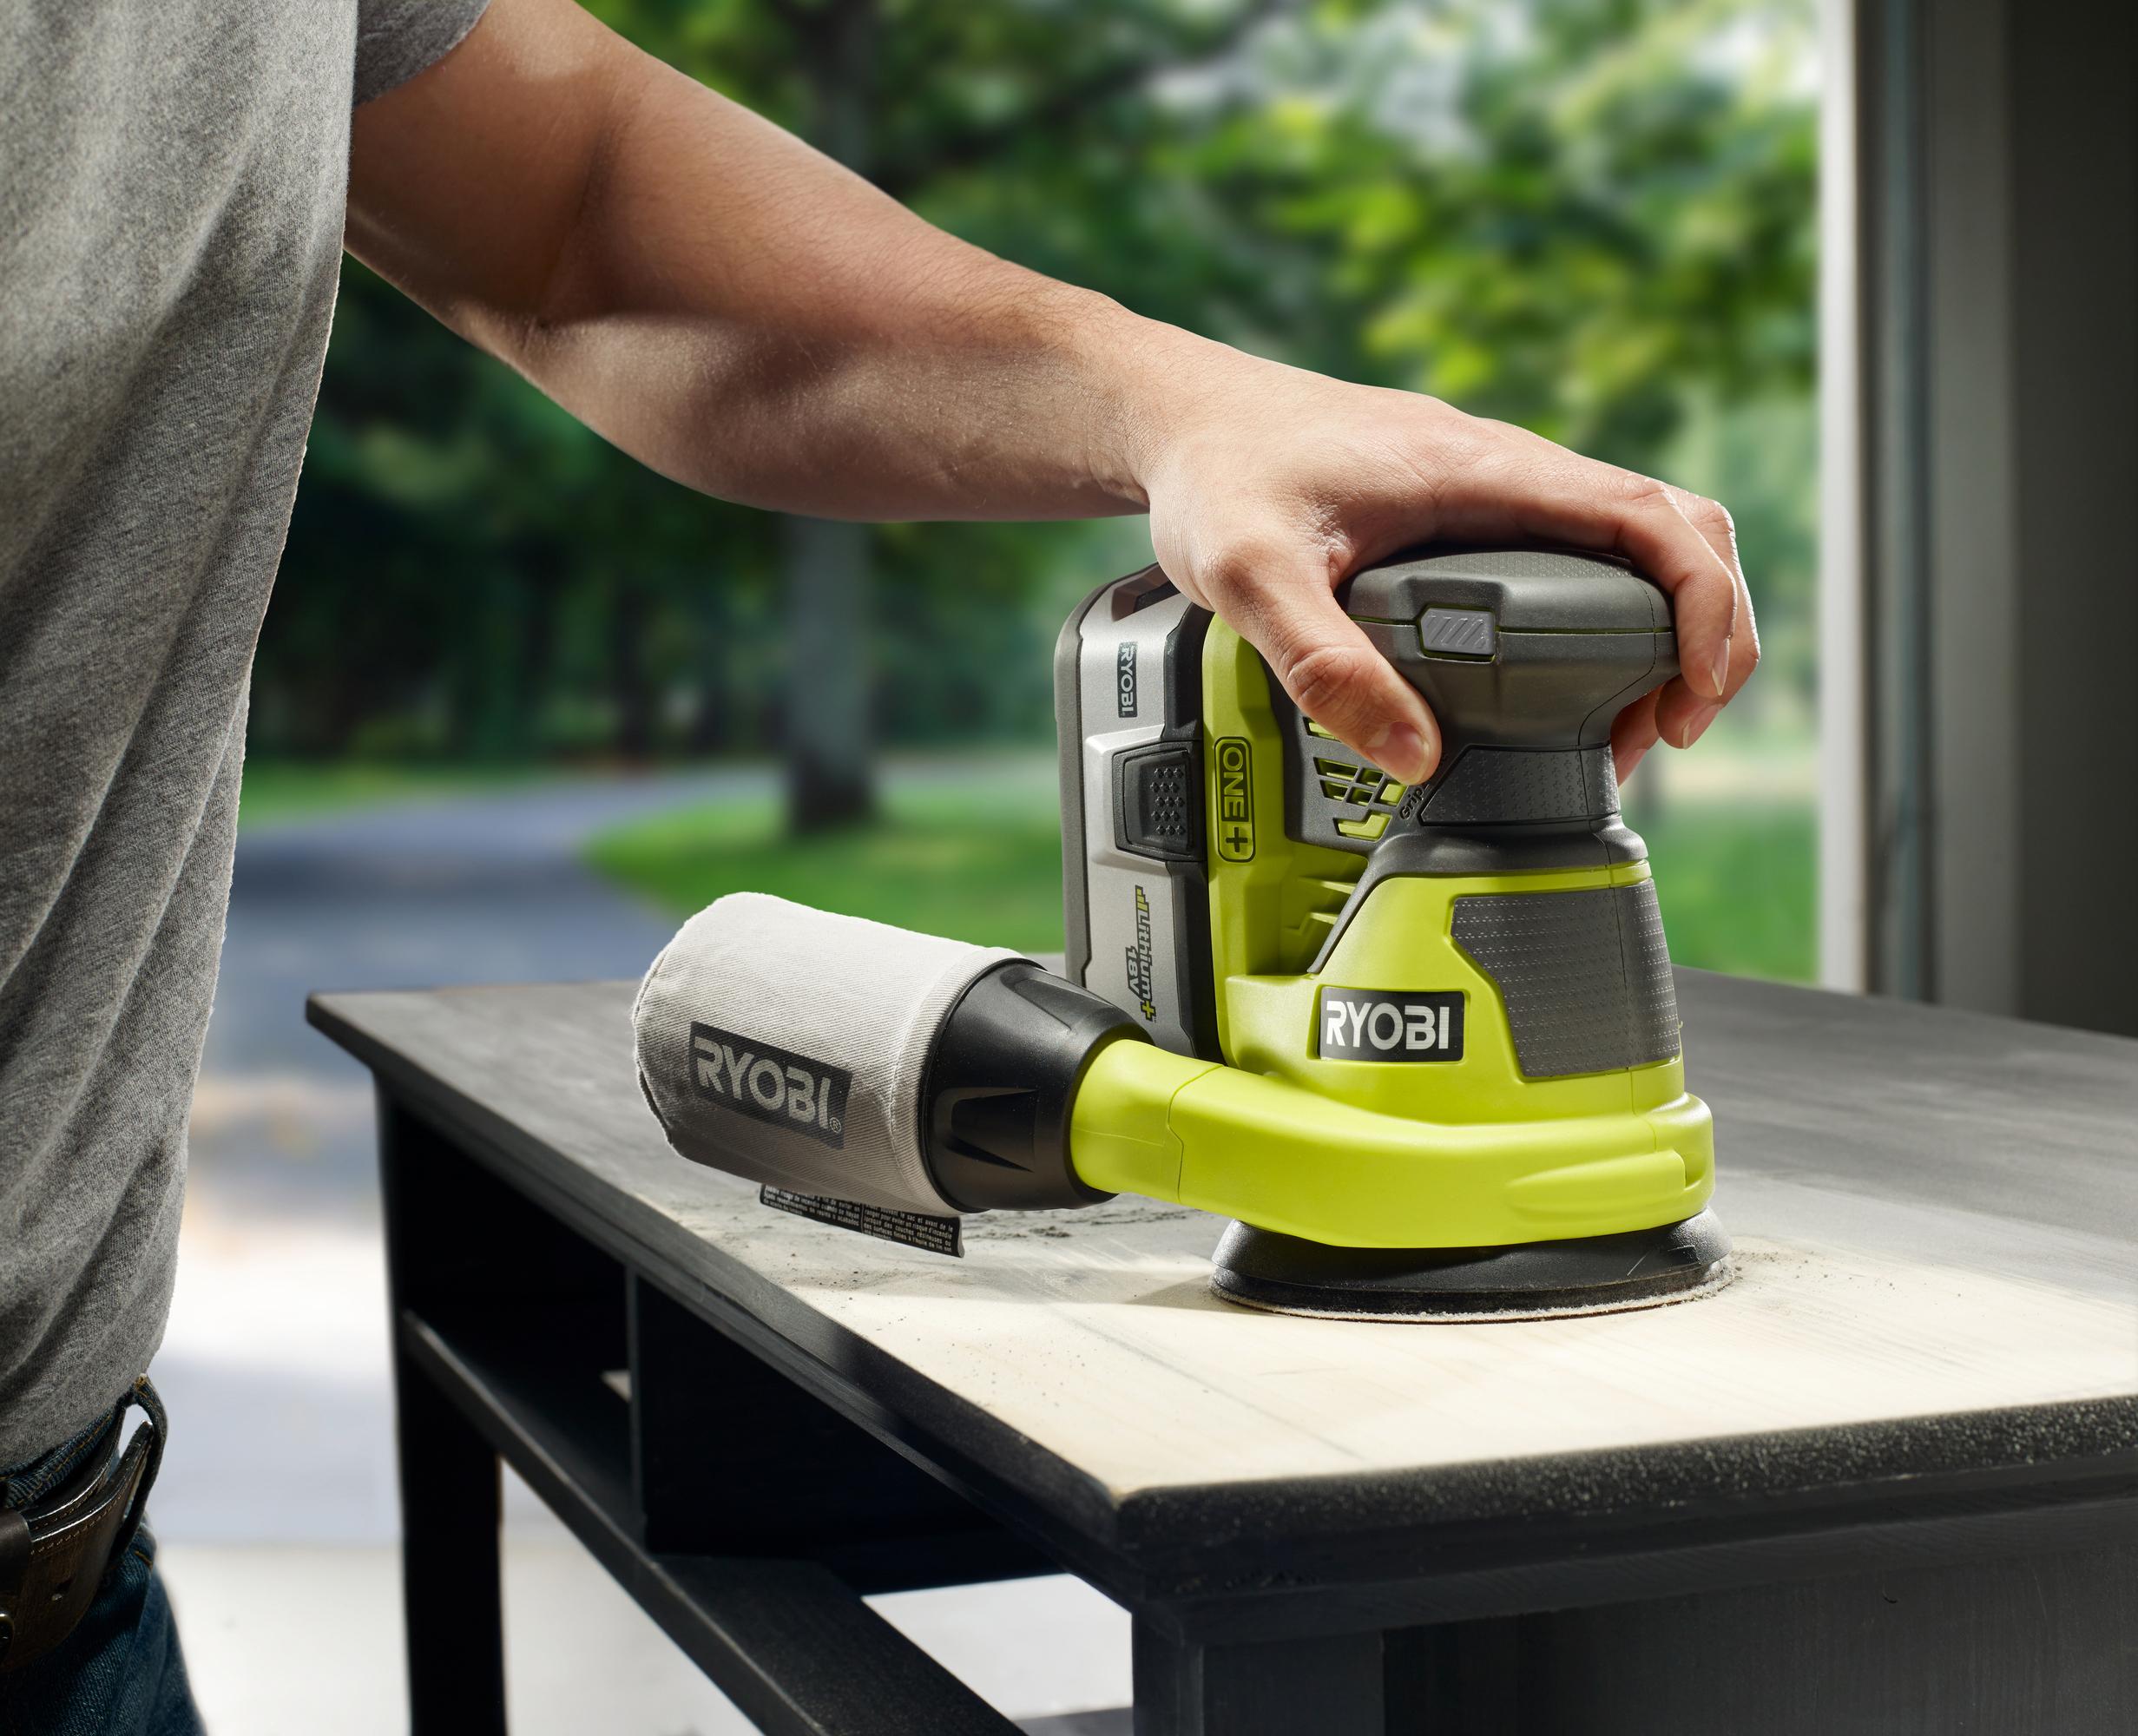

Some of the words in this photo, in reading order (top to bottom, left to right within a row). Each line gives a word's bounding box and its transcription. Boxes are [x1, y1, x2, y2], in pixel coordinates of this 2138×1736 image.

[1119, 642, 1136, 713] RYOBI
[1399, 786, 1424, 820] Grip
[1126, 945, 1144, 1000] 18V
[1326, 1000, 1451, 1050] RYOBI
[695, 1036, 832, 1130] RYOBI
